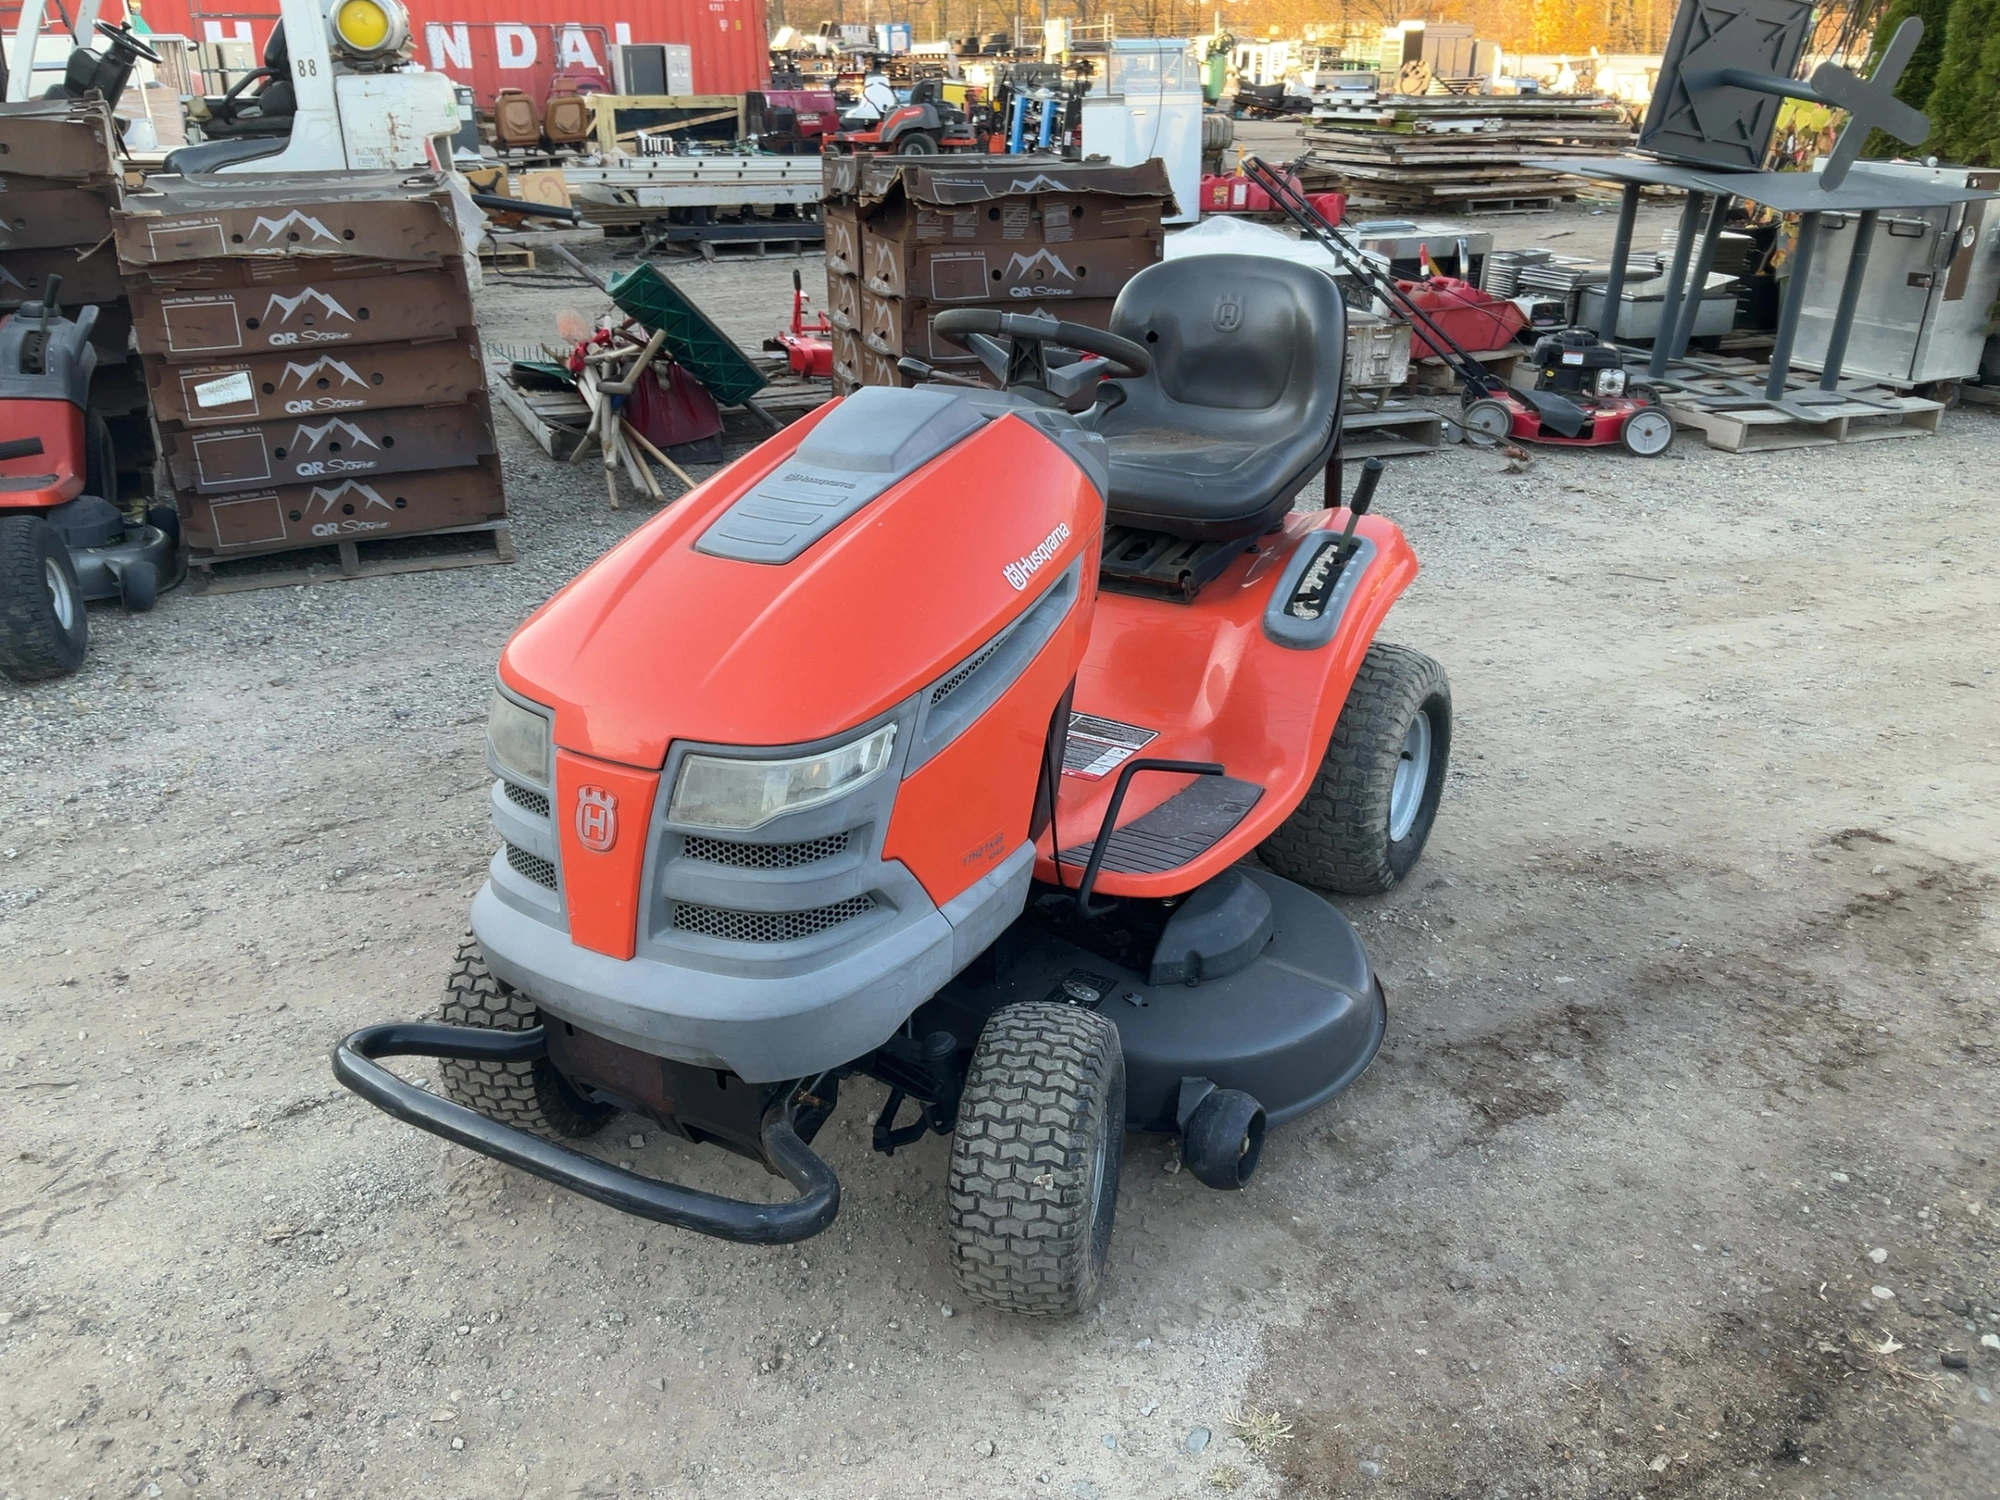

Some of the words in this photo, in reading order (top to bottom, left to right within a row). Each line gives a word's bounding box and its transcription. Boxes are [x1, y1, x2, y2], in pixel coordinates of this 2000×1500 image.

[297, 58, 317, 77] 88
[1008, 286, 1034, 298] QR
[268, 332, 299, 346] QR
[299, 330, 353, 344] Stone
[285, 399, 315, 414] QR
[315, 397, 367, 411] Stone
[296, 461, 326, 477] QR
[325, 458, 378, 474] Stone
[311, 522, 341, 537] QR
[340, 519, 391, 534] Stone
[1014, 522, 1071, 580] Husqvarna
